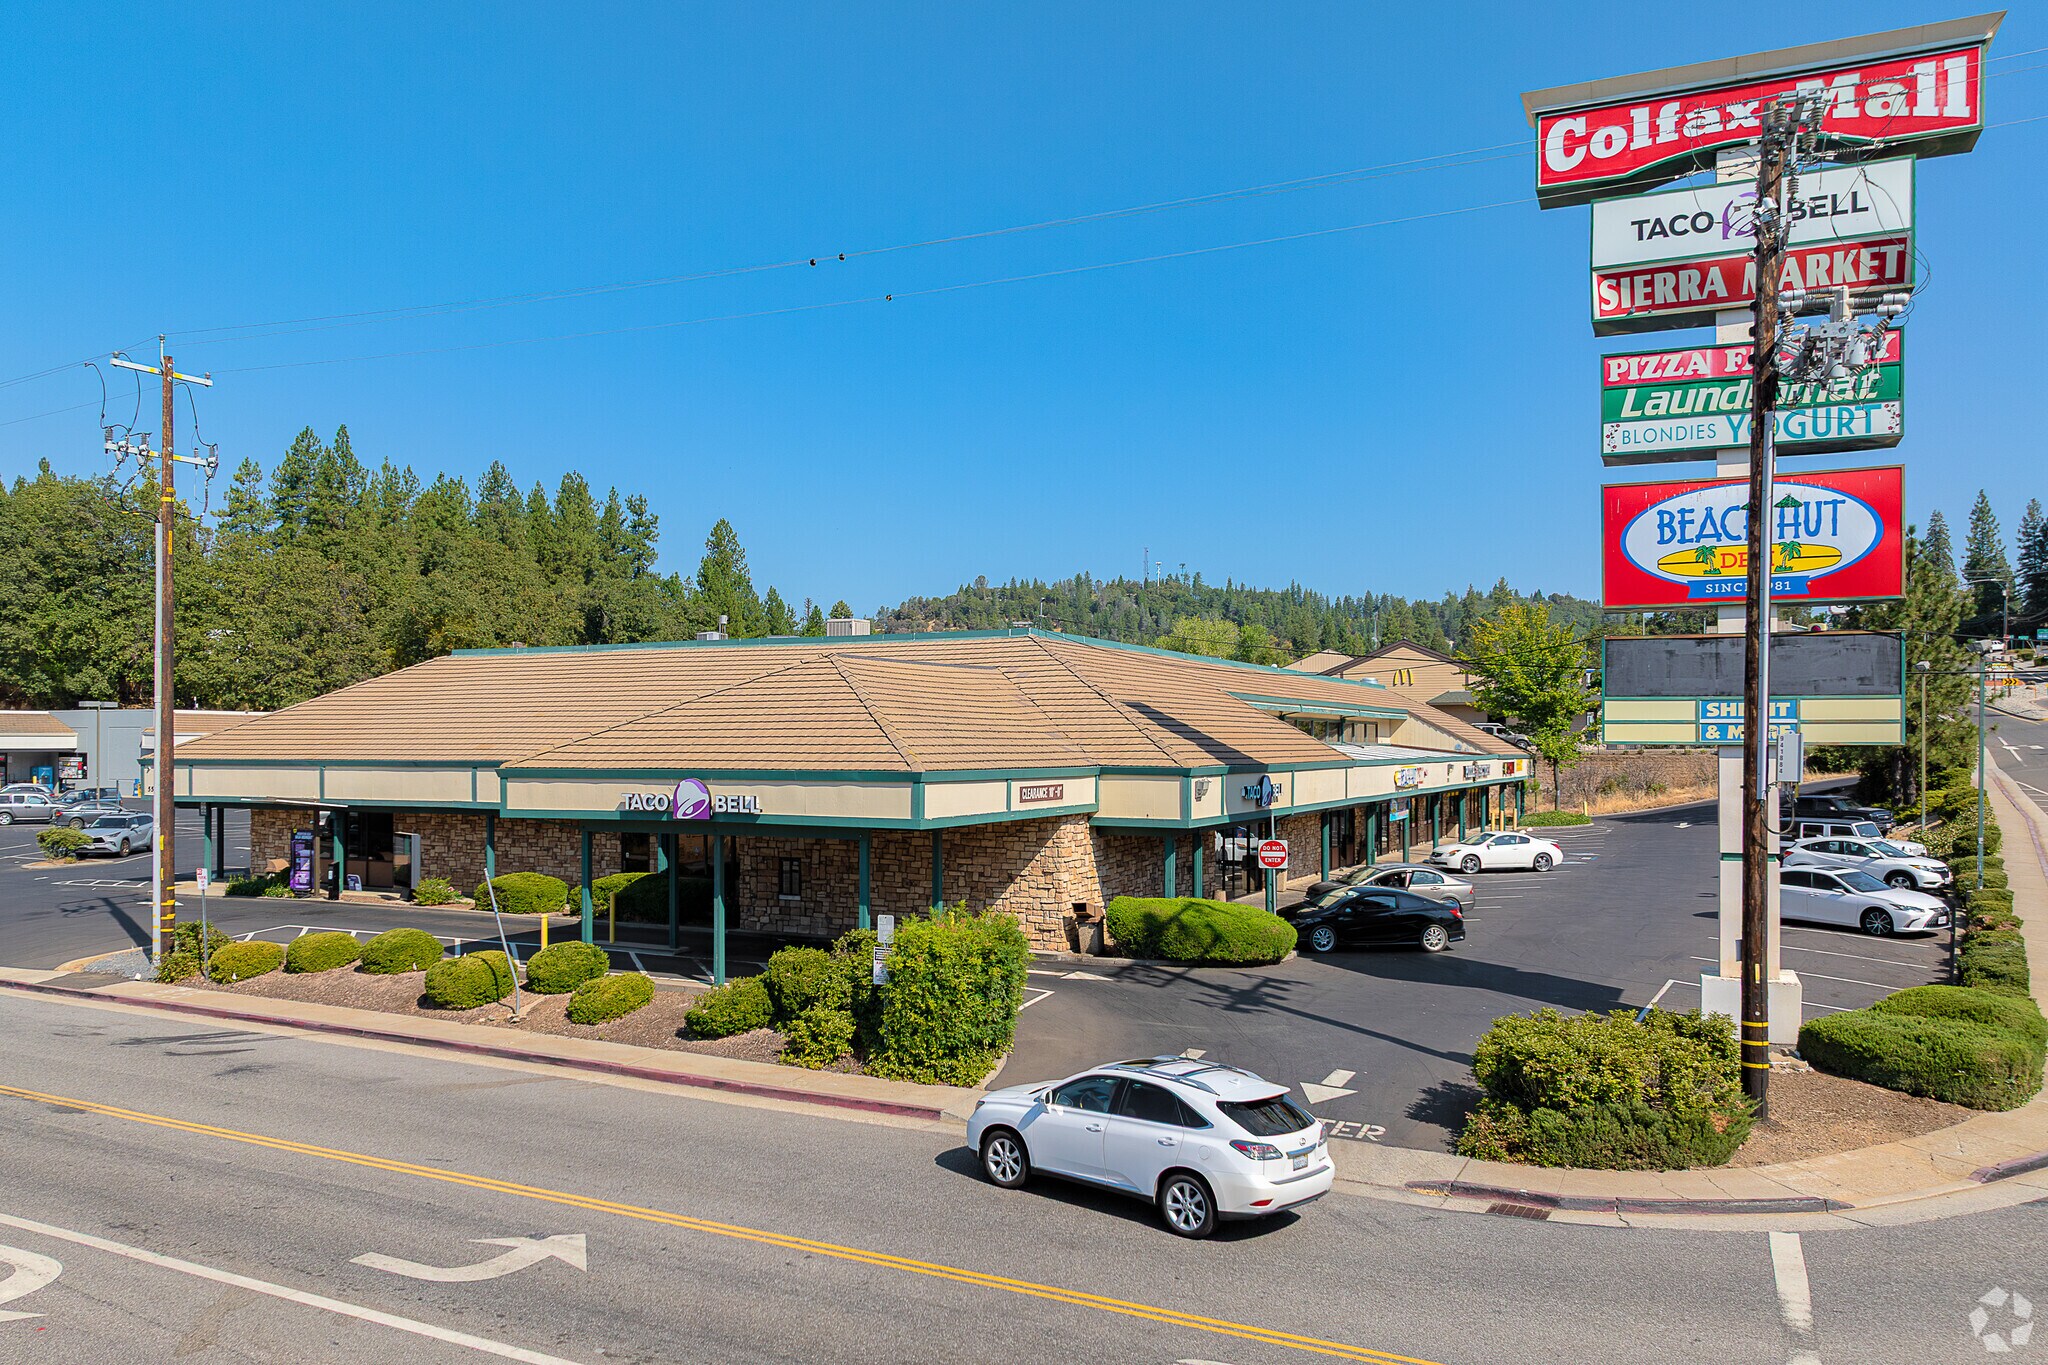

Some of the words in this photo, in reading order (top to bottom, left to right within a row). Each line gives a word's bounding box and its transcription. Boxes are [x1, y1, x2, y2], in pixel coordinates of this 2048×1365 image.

[1545, 101, 1760, 172] Colfax
[1796, 55, 1970, 118] Mall
[1631, 211, 1714, 241] TACO
[1787, 191, 1869, 221] BELL
[1600, 266, 1729, 311] SIERRA
[1608, 351, 1710, 382] PIZZA
[1622, 423, 1717, 445] BLONDIES
[1726, 404, 1882, 443] YGURT
[1657, 505, 1750, 545] BEAC
[1777, 498, 1846, 539] HUT
[1705, 582, 1748, 593] SINC
[1705, 724, 1721, 739] &
[1727, 724, 1792, 739] MRE
[621, 793, 670, 811] TACO
[715, 795, 762, 813] BELL
[1022, 787, 1048, 800] CLEARANCE
[1247, 785, 1261, 800] TACO
